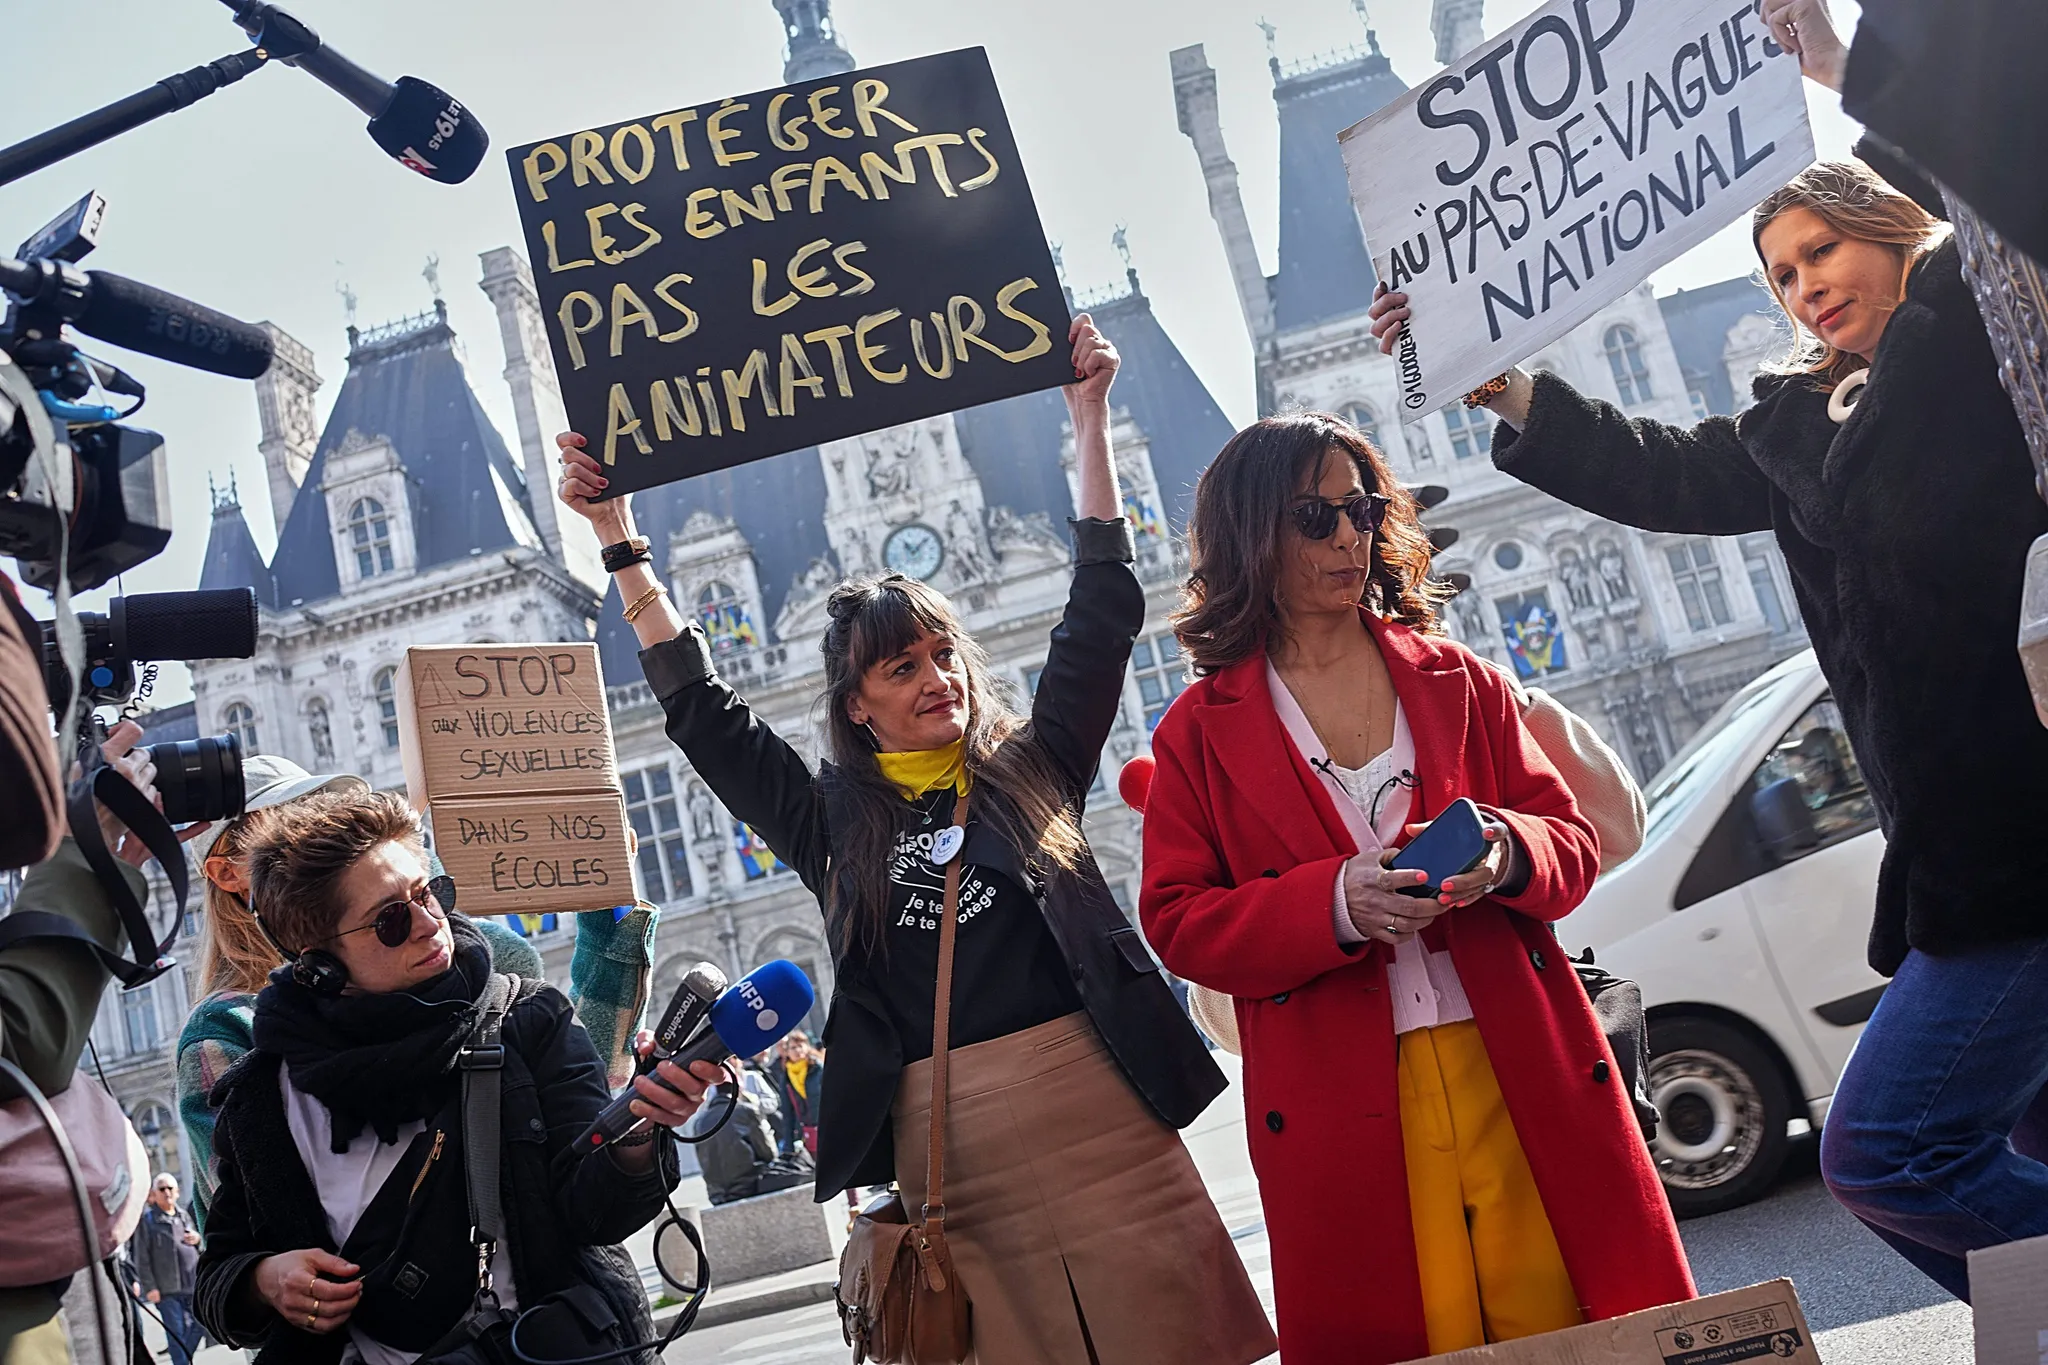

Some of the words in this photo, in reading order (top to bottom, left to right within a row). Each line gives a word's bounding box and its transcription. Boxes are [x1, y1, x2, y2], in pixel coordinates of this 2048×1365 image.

[1416, 0, 1635, 186] STOP
[523, 79, 918, 202] PROTÉGER
[541, 202, 662, 273] LES
[685, 127, 999, 239] ENFANTS
[1389, 228, 1430, 291] AU
[558, 273, 699, 370] PAS
[751, 238, 875, 316] LES
[455, 653, 576, 699] STOP
[432, 717, 461, 735] aux
[460, 748, 605, 780] SEXUELLES
[458, 817, 529, 845] DANS
[548, 814, 606, 840] NOS
[491, 851, 609, 892] ÉCOLES
[905, 892, 925, 910] je
[928, 899, 944, 914] te
[957, 878, 982, 910] rois
[896, 909, 916, 926] je
[919, 916, 937, 930] te
[737, 980, 765, 1010] AFP
